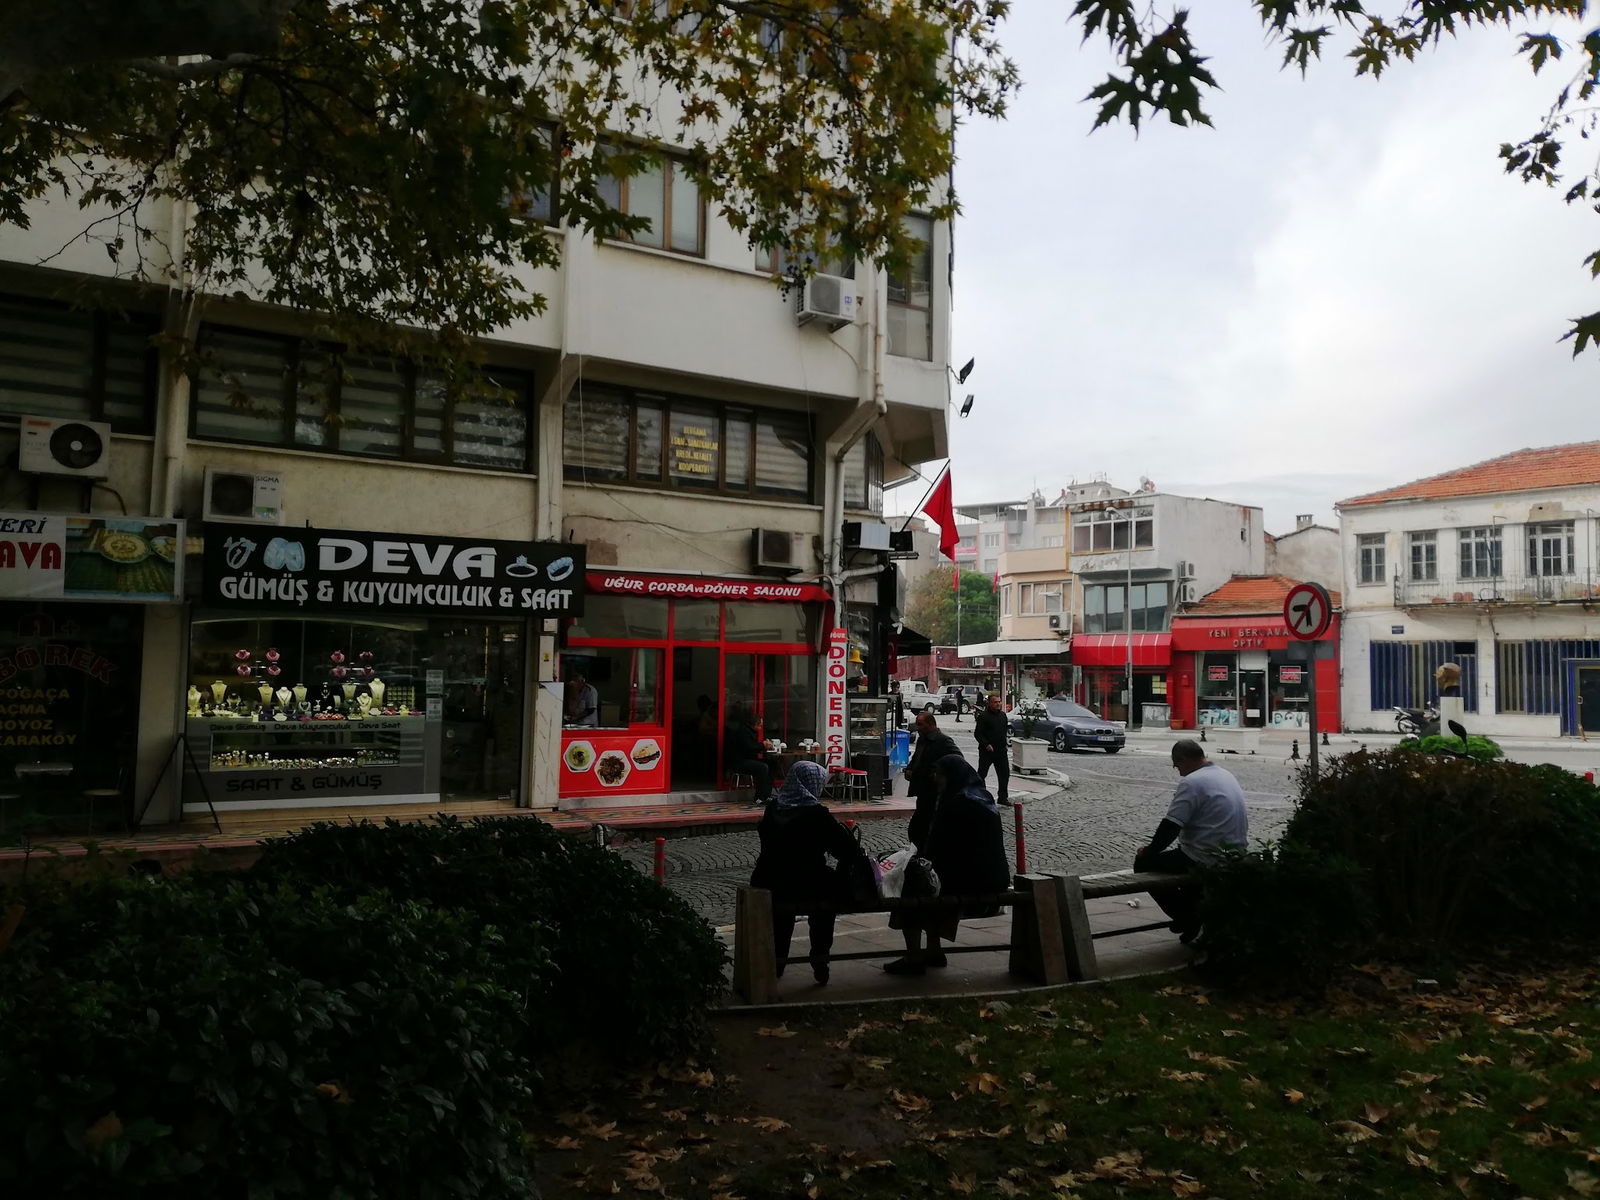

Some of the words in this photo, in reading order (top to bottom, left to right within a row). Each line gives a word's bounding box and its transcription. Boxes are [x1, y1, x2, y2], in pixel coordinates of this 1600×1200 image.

[0, 516, 47, 534] ERİ
[317, 538, 497, 581] DEVA
[220, 571, 309, 606] GÜMÜŞ
[317, 580, 334, 602] &
[343, 581, 493, 607] KUYUMCULUK
[499, 587, 514, 608] &
[521, 588, 573, 611] SAAT
[604, 576, 644, 590] UĞUR
[648, 581, 695, 593] ÇORBA
[704, 582, 748, 595] DÖNER
[753, 586, 801, 597] SALONU
[827, 646, 845, 727] DÖNER
[226, 778, 283, 793] SAAT
[291, 777, 306, 791] &
[312, 772, 383, 790] GÜMÜŞ
